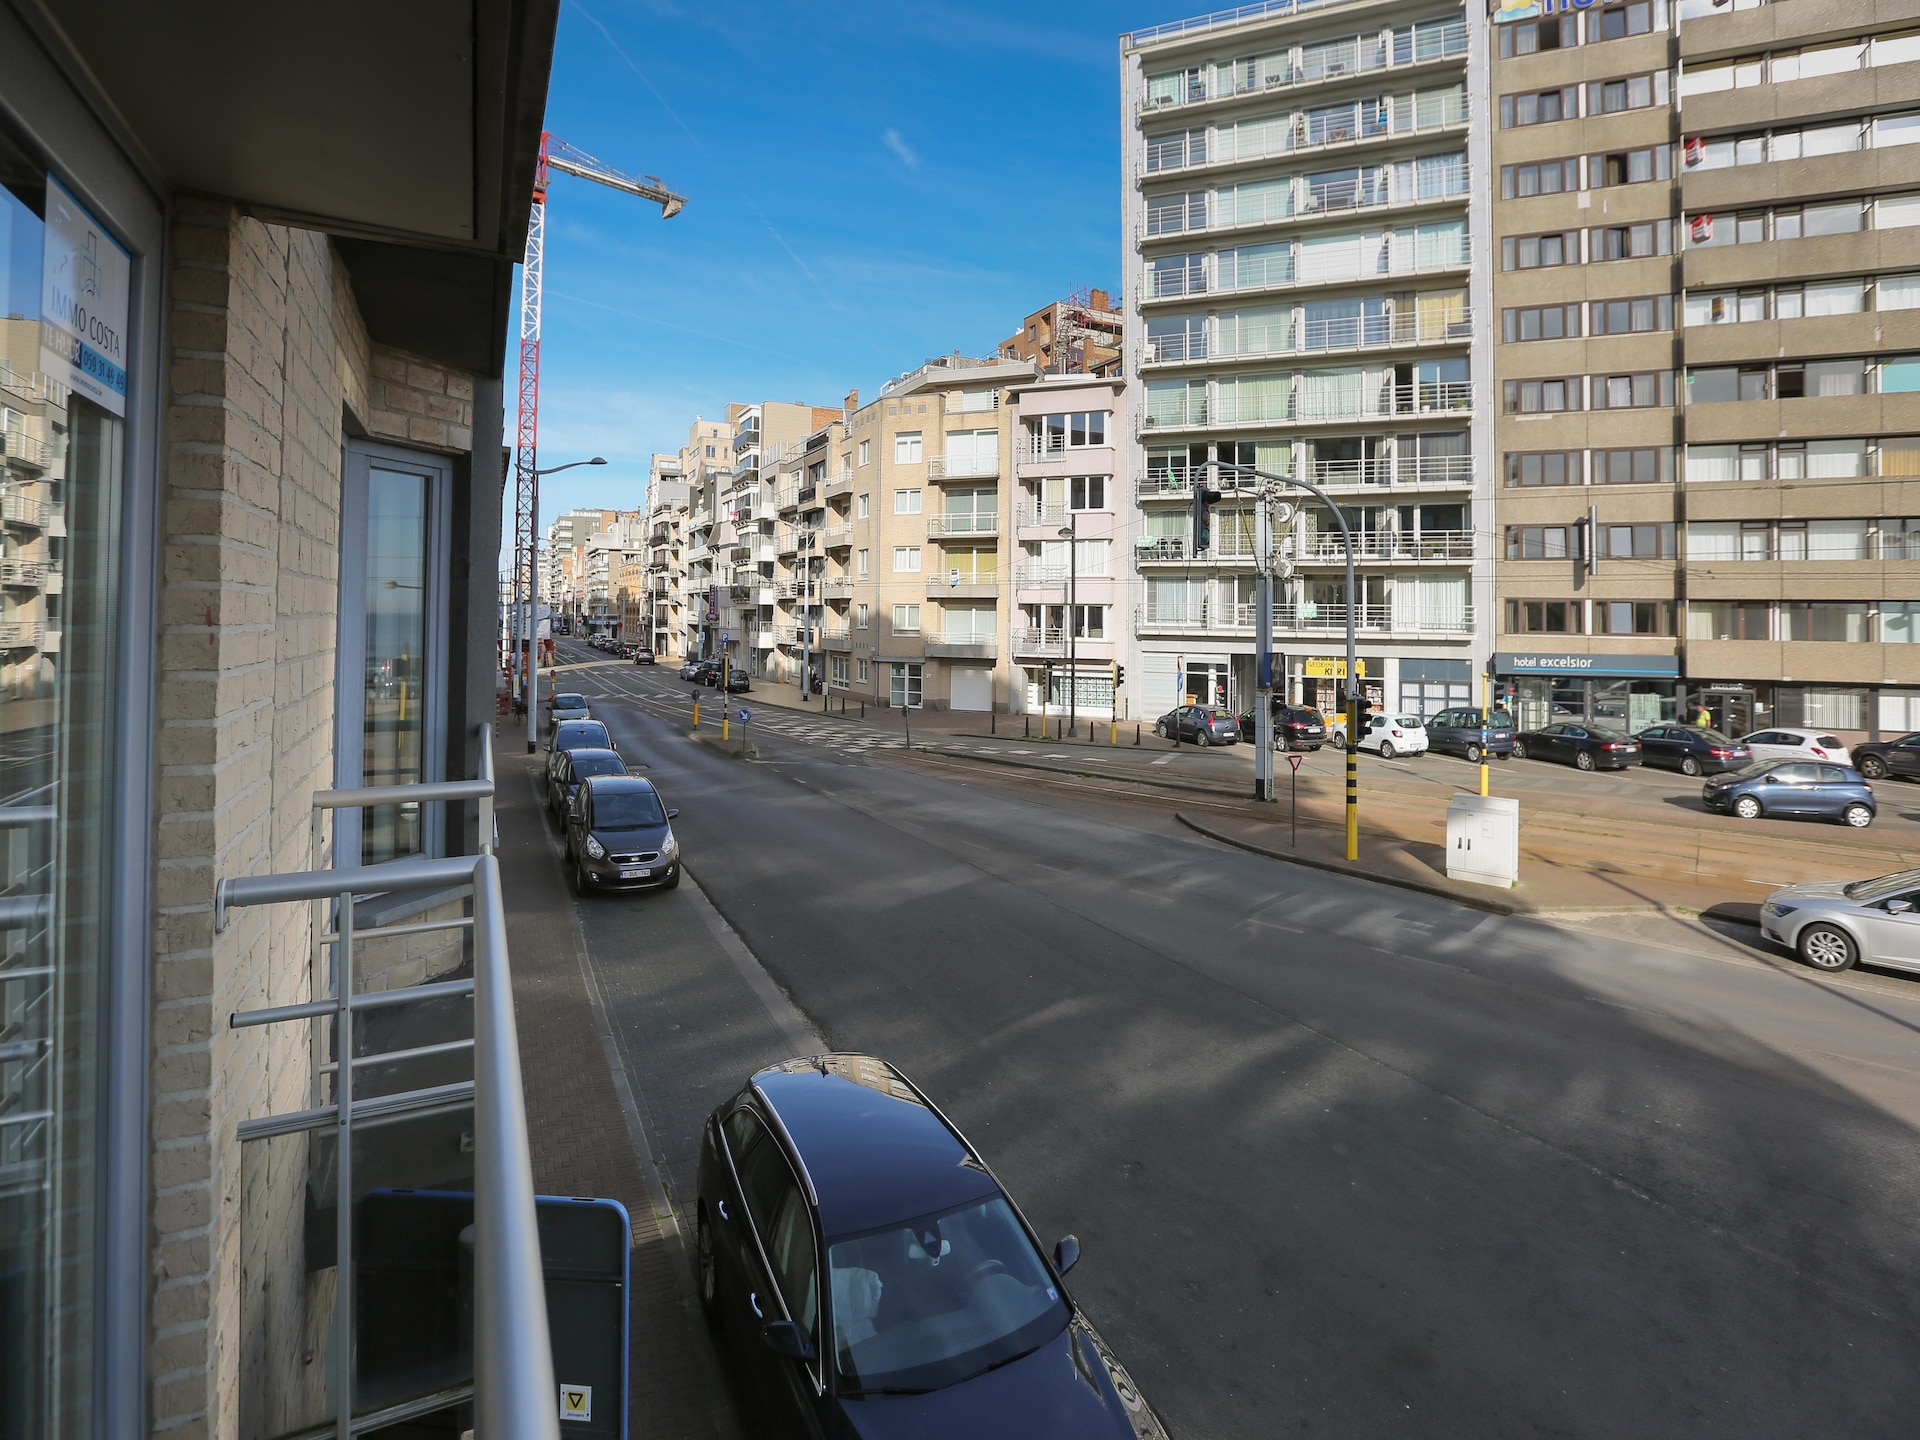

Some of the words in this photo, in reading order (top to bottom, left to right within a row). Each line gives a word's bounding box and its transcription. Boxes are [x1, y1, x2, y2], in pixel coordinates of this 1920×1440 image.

[52, 284, 87, 332] IMMO
[90, 316, 120, 359] COSTA
[44, 323, 53, 346] TE
[55, 329, 81, 364] HUUR
[83, 350, 97, 373] 059
[98, 360, 105, 377] 31
[106, 366, 115, 385] 49
[116, 372, 125, 390] 49
[1513, 656, 1537, 667] hotel
[1540, 655, 1593, 668] excelsior
